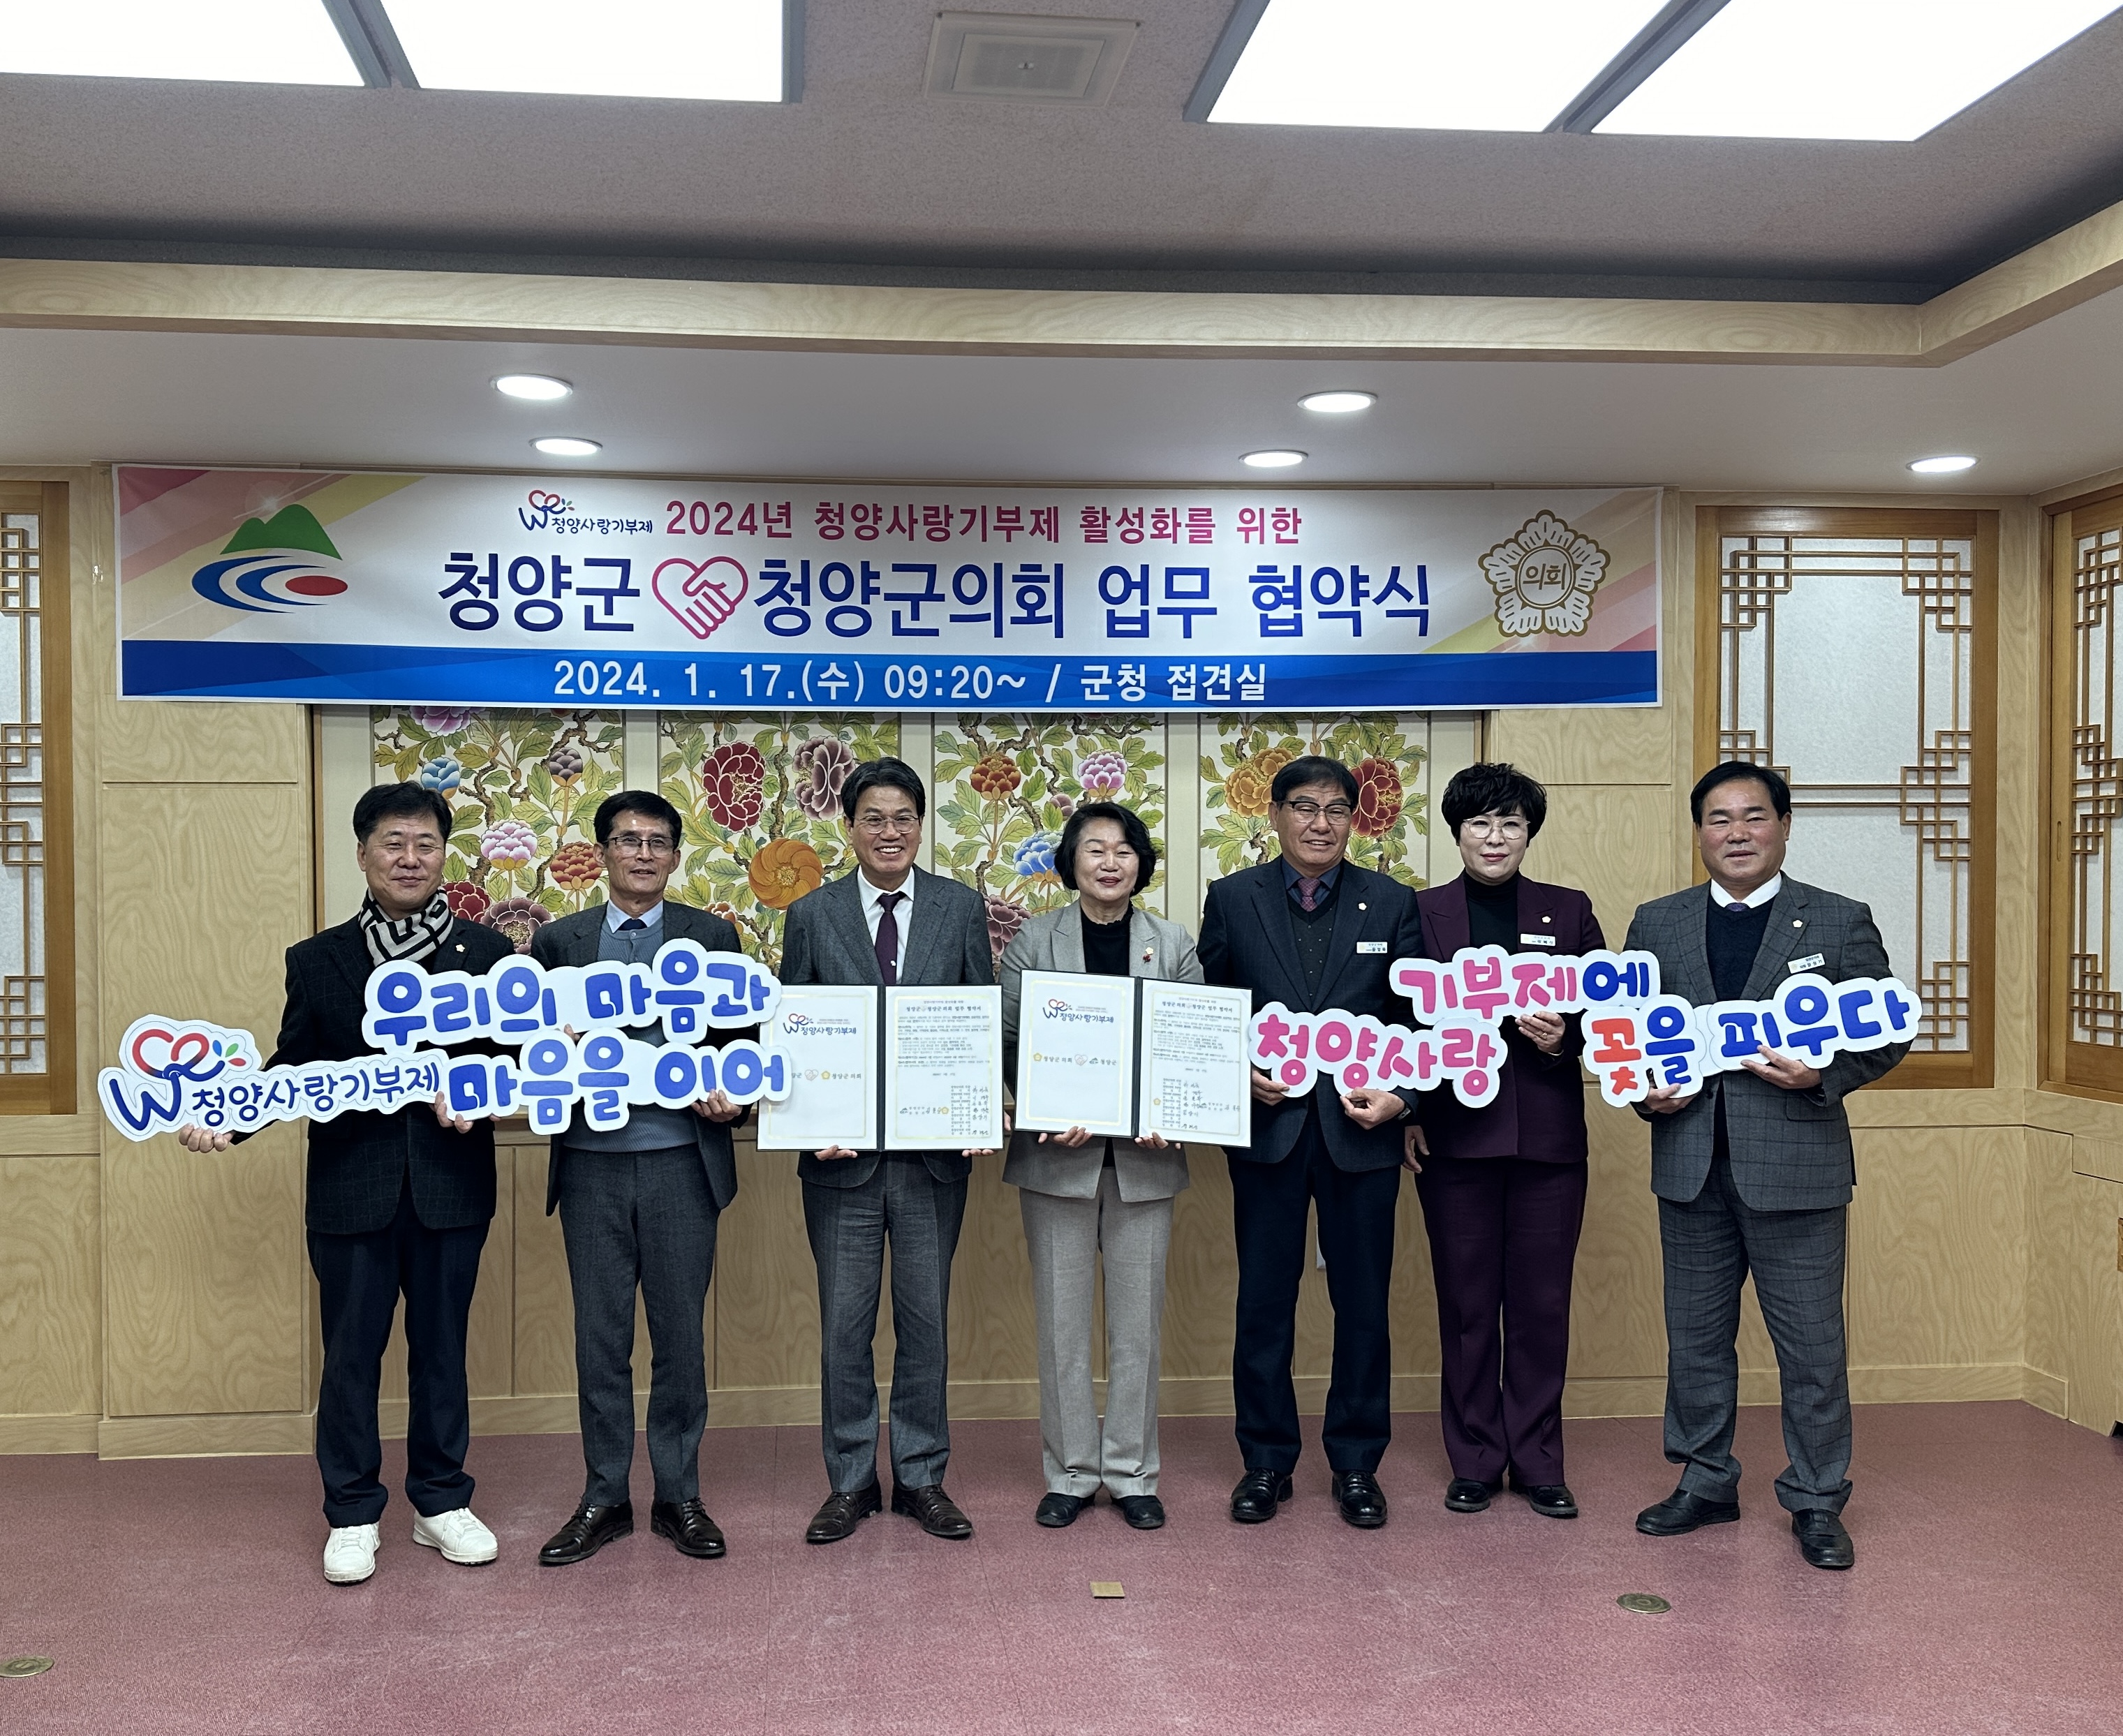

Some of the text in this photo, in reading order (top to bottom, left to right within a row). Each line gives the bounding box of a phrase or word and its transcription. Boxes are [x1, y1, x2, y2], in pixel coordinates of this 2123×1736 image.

[551, 518, 653, 535] 청양사랑기부제
[666, 500, 1301, 544] 2024년 청양사랑기부제 활성화를 위한
[438, 551, 1428, 639] 청양군 청양군의회 업무 협약식
[1522, 564, 1567, 591] 의회
[554, 660, 1266, 703] 2024. 1. 17.(수) 09:20~ / 군청 접견실
[374, 949, 770, 1046] 우리의 마음과
[1398, 956, 1648, 1020] 기부제에
[1257, 1014, 1497, 1097] 청양사랑
[1592, 985, 1910, 1095] 꽃을 피우다
[192, 1061, 441, 1127] 청양사랑기부제
[448, 1036, 784, 1125] 마음을 이어
